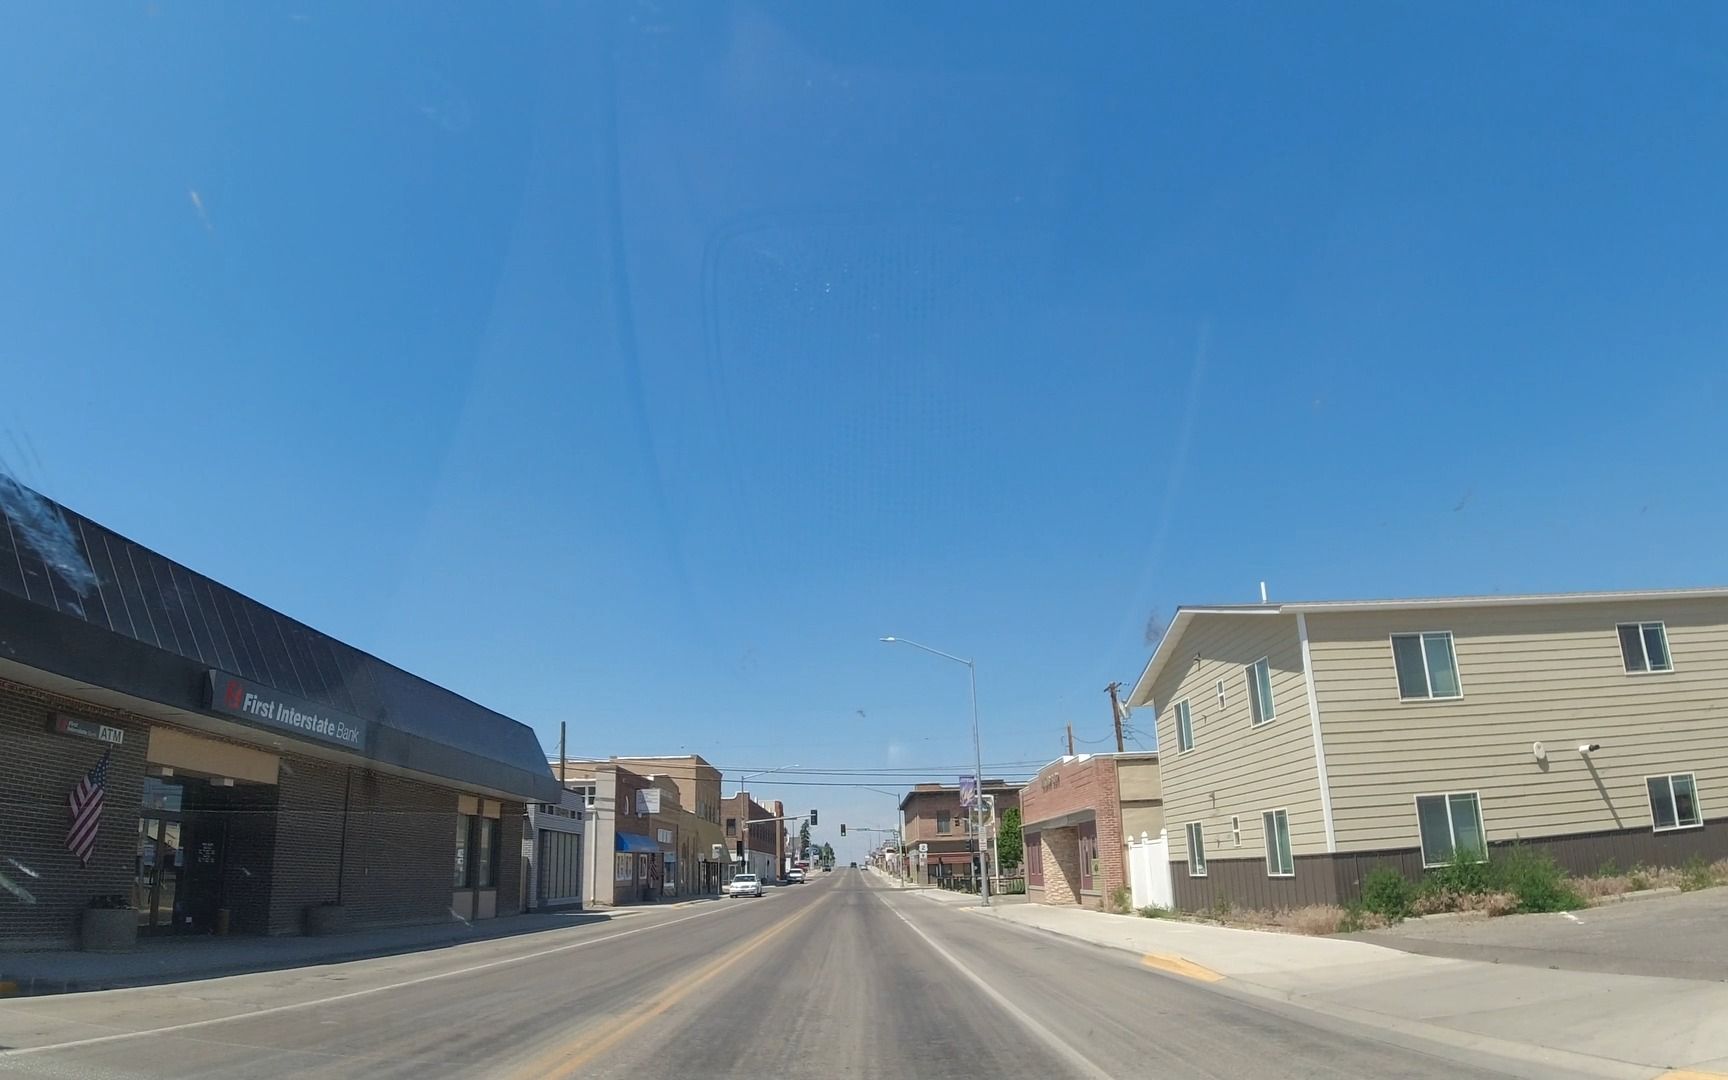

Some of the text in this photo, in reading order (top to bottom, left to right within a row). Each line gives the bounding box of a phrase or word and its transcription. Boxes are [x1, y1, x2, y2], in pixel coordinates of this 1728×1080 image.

[242, 692, 360, 743] First Interstate Bank
[101, 727, 121, 743] ATM
